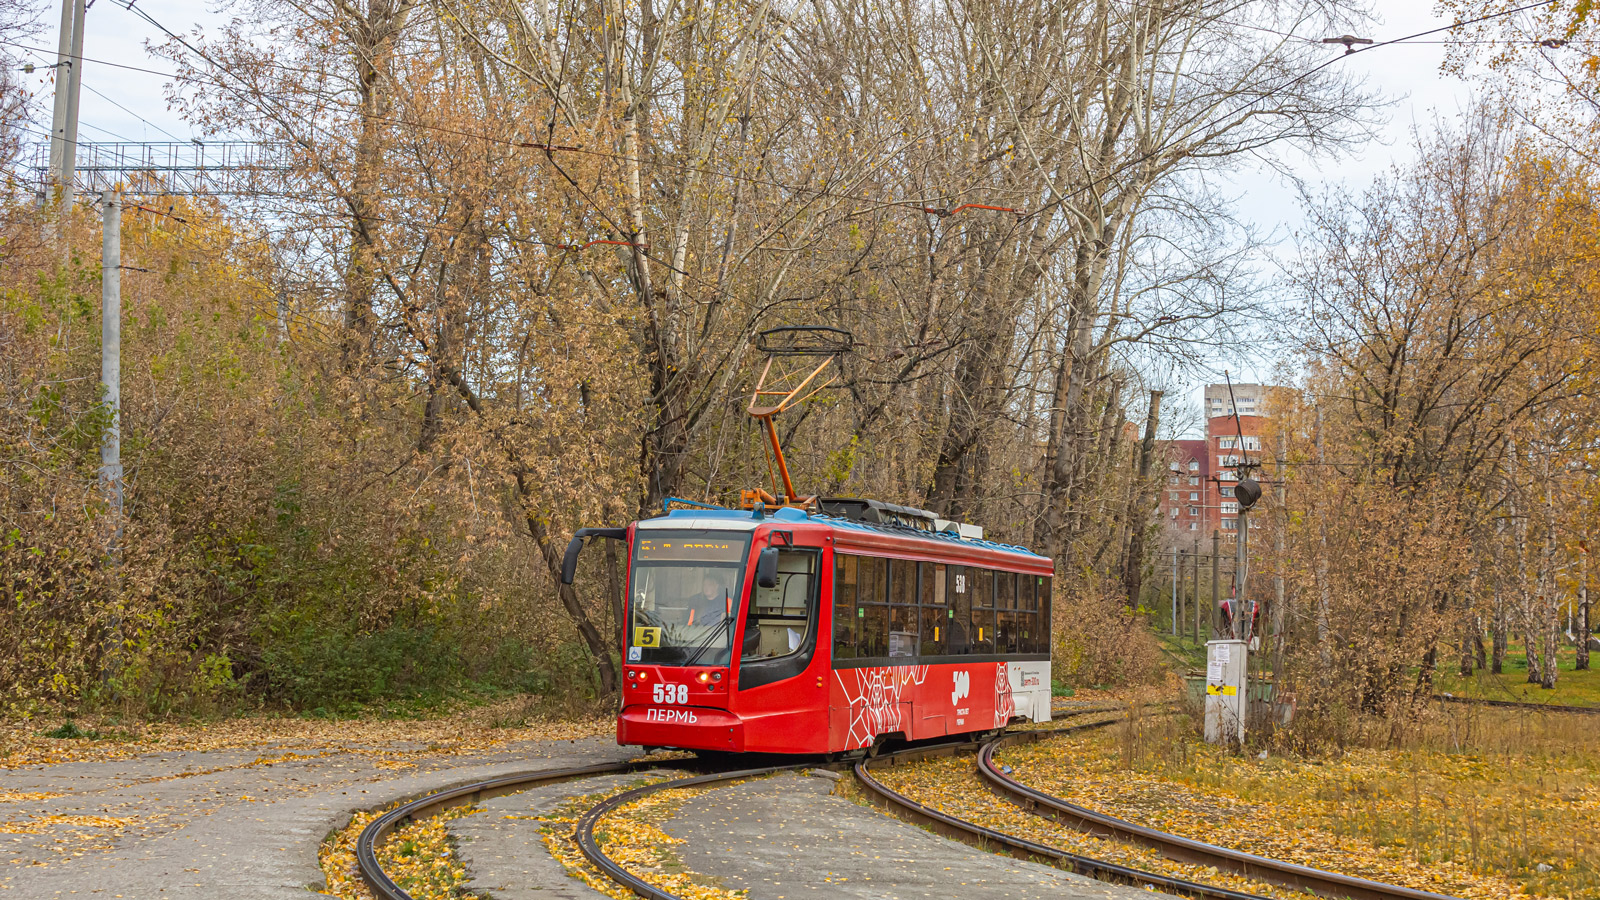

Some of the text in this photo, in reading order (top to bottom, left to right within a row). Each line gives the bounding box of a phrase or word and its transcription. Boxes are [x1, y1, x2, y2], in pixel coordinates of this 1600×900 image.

[956, 574, 965, 593] 538
[642, 629, 654, 645] 5
[653, 684, 688, 704] 538
[646, 708, 698, 724] ПЕРМЬ
